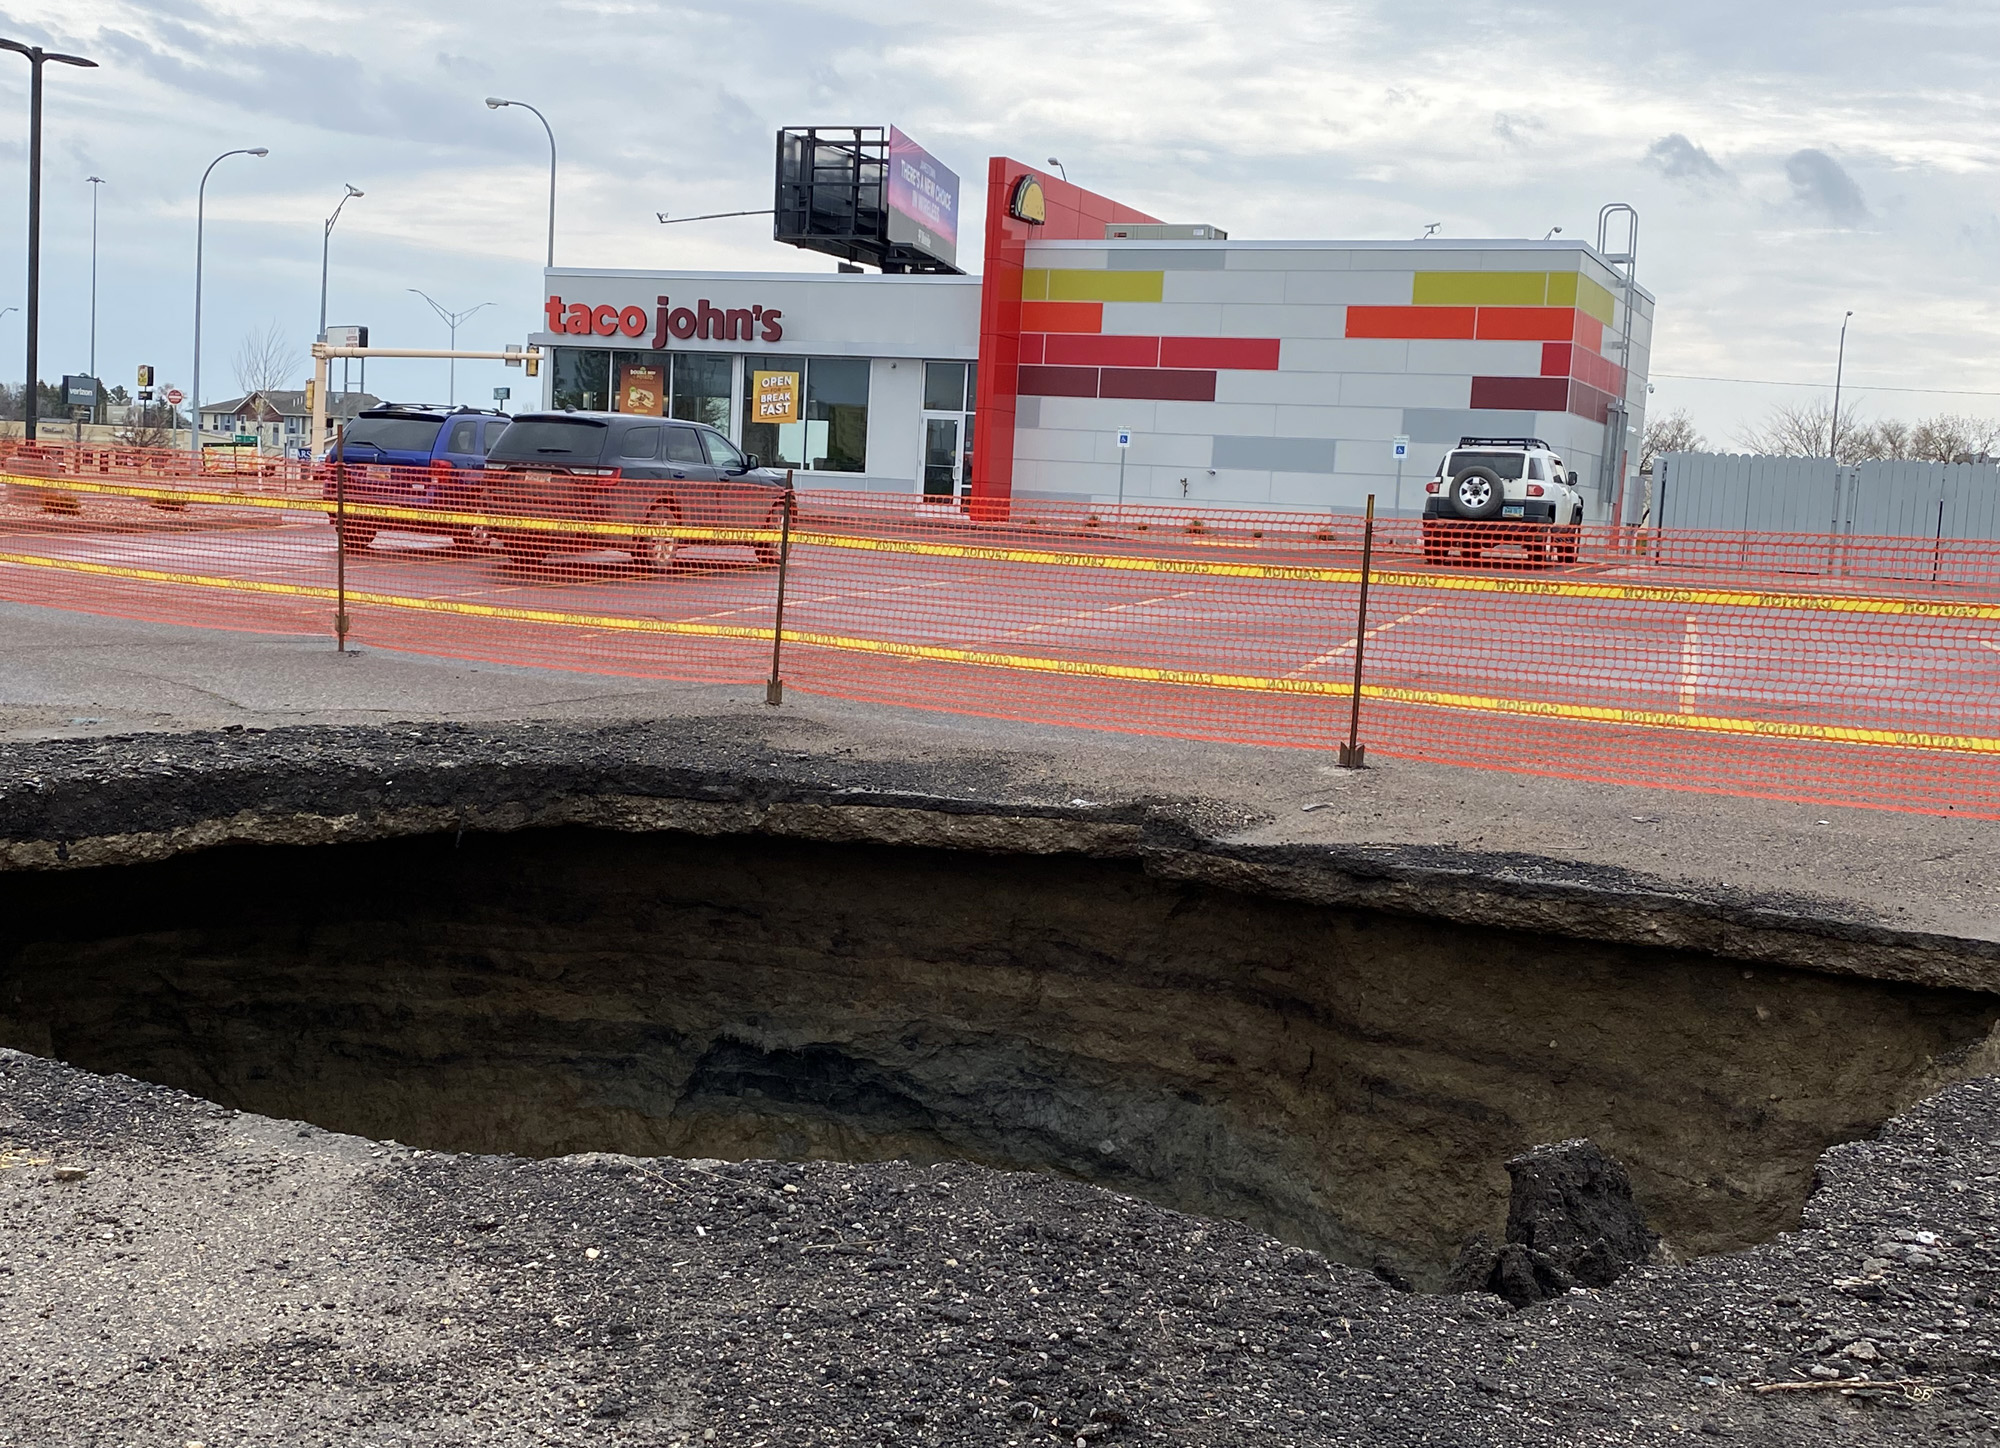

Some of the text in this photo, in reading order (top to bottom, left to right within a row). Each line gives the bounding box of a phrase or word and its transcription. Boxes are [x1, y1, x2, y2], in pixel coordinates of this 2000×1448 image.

[545, 295, 783, 350] taco john's
[761, 375, 792, 388] OPEN
[69, 387, 93, 396] verizon
[760, 392, 791, 403] BREAK
[760, 402, 791, 416] FAST
